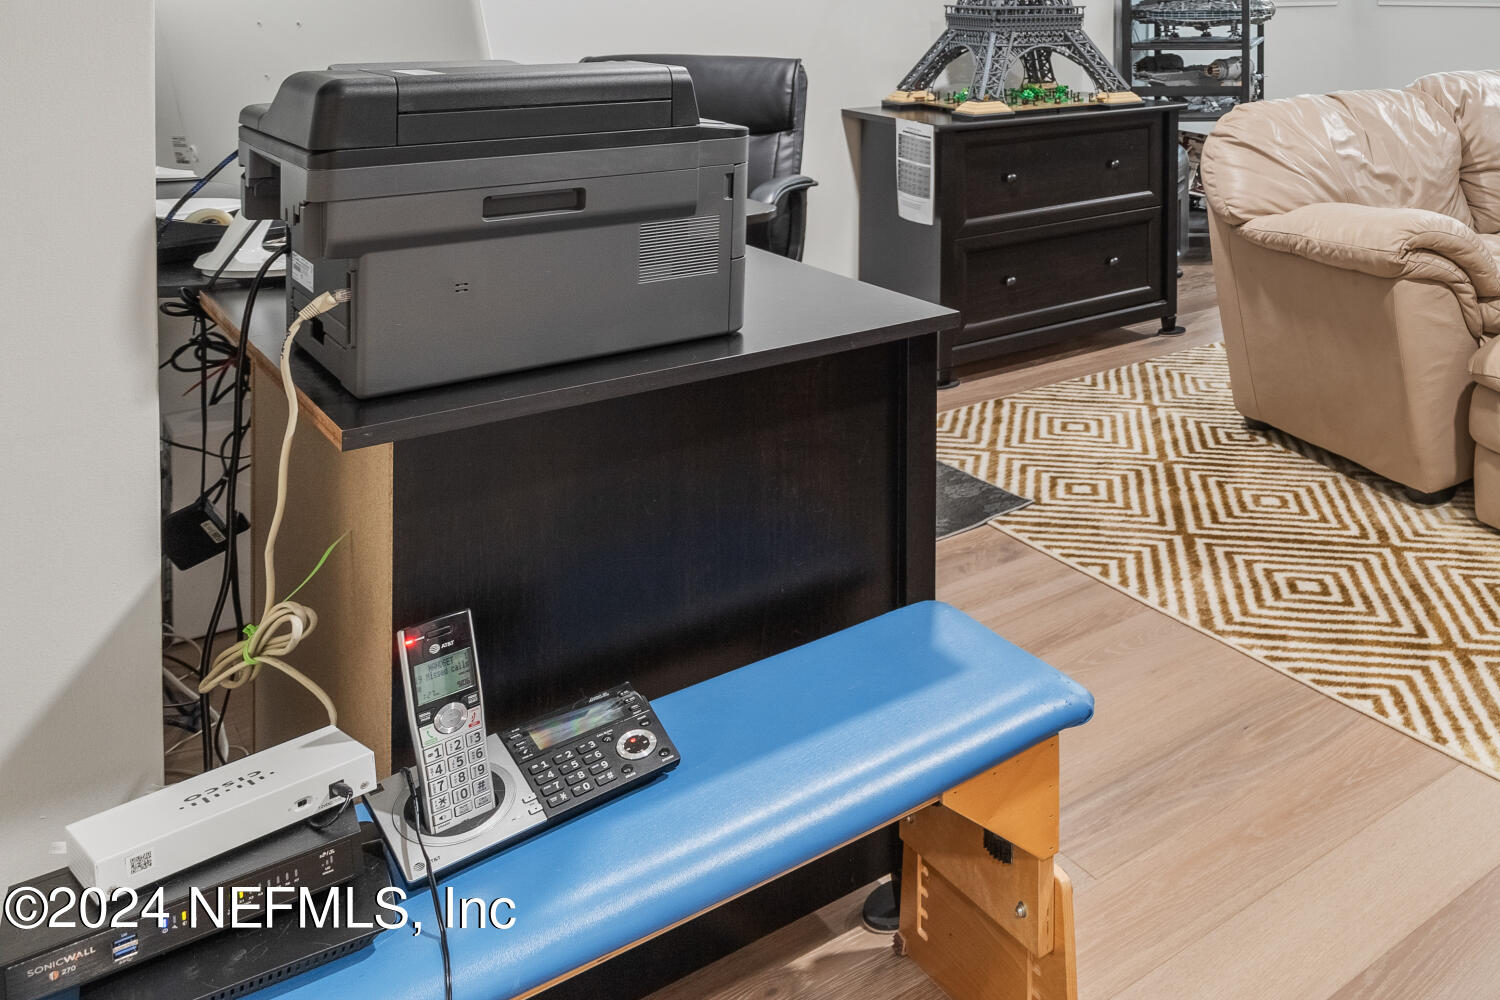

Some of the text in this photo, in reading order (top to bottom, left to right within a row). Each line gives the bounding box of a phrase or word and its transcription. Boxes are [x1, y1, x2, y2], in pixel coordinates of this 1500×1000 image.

[441, 640, 455, 649] AT&T
[434, 732, 481, 758] 1 2 3
[540, 740, 596, 769] 1 2 3
[435, 747, 483, 775] 4 5 6
[547, 750, 602, 778] 4 5 6
[553, 760, 609, 789] 7 8 9
[184, 770, 261, 802] cisco
[437, 764, 485, 791] 7 8 9
[582, 782, 591, 790] 0
[460, 788, 468, 799] 0
[27, 946, 97, 978] SONICWALL
[61, 966, 77, 976] 270
